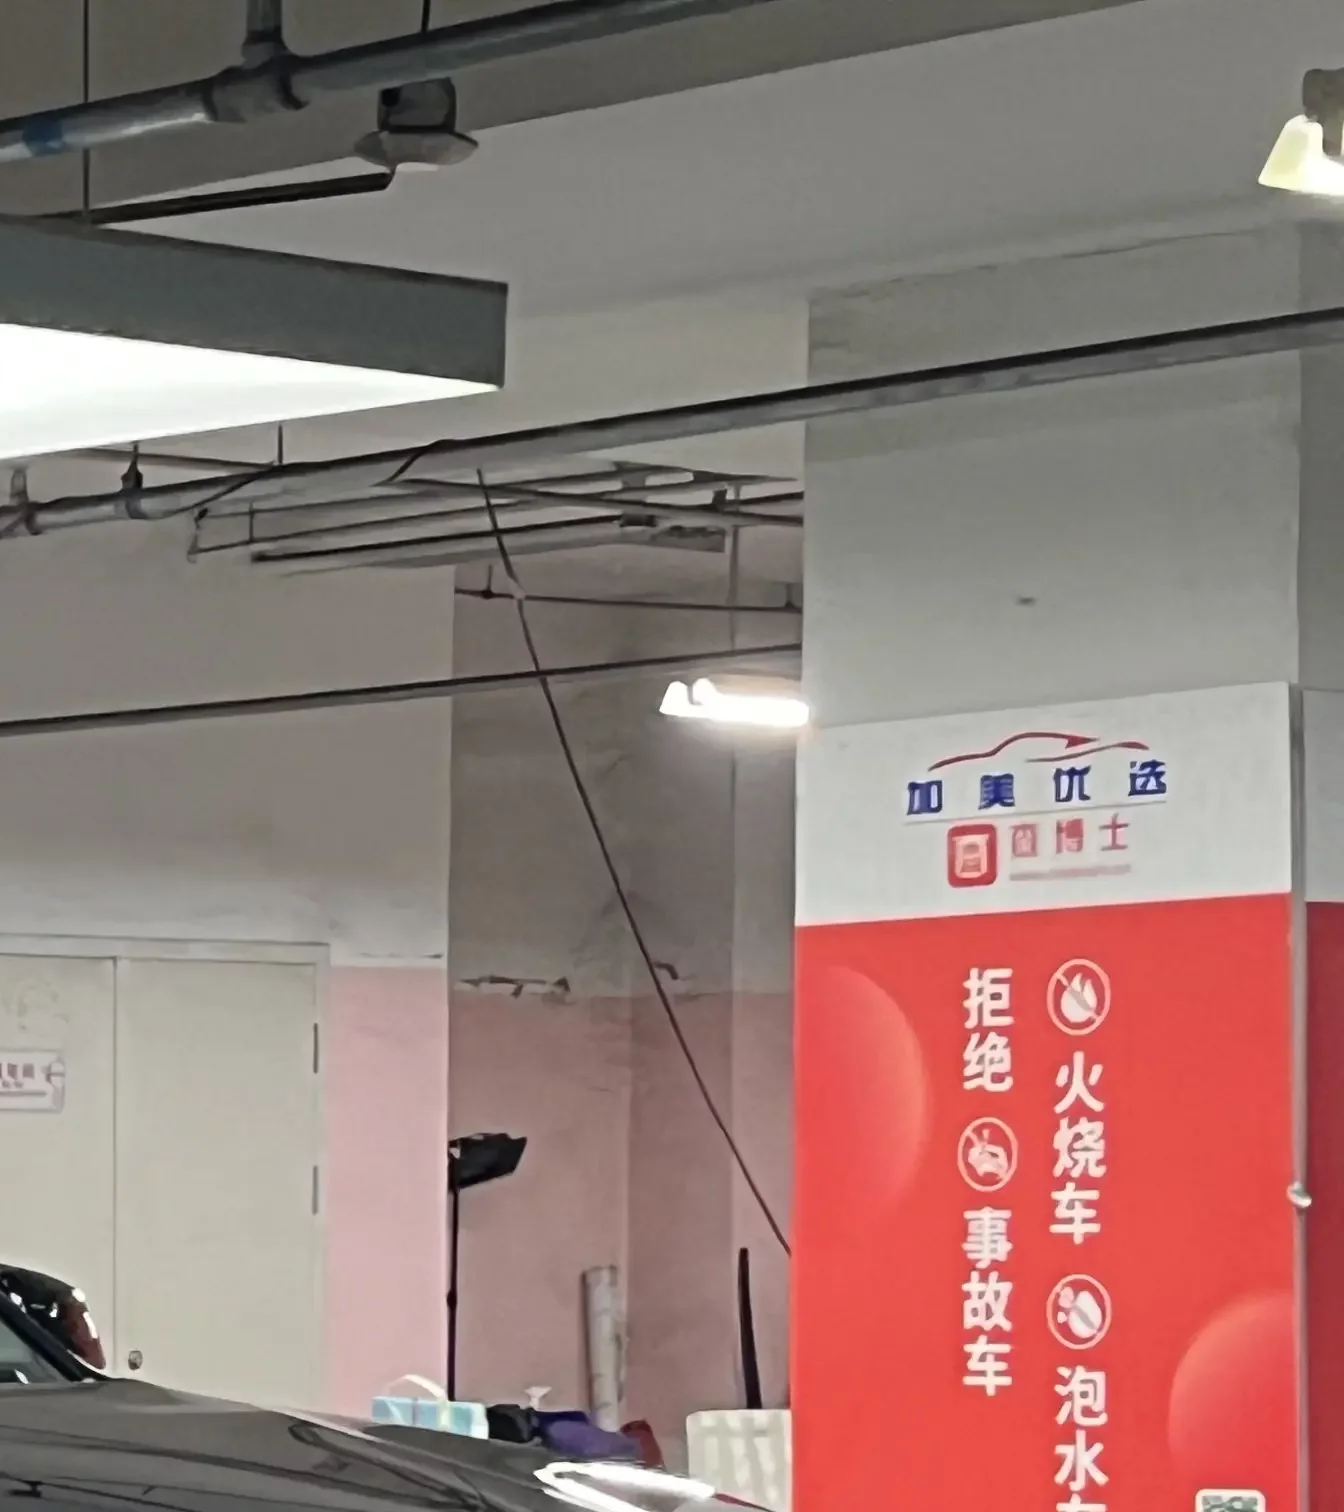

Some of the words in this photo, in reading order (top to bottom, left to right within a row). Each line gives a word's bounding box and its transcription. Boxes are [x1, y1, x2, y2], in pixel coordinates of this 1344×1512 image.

[906, 758, 1167, 816] 加美优选
[962, 966, 1014, 1093] 拒绝
[1049, 1050, 1107, 1245] 火烧车
[961, 1205, 1013, 1397] 事故车
